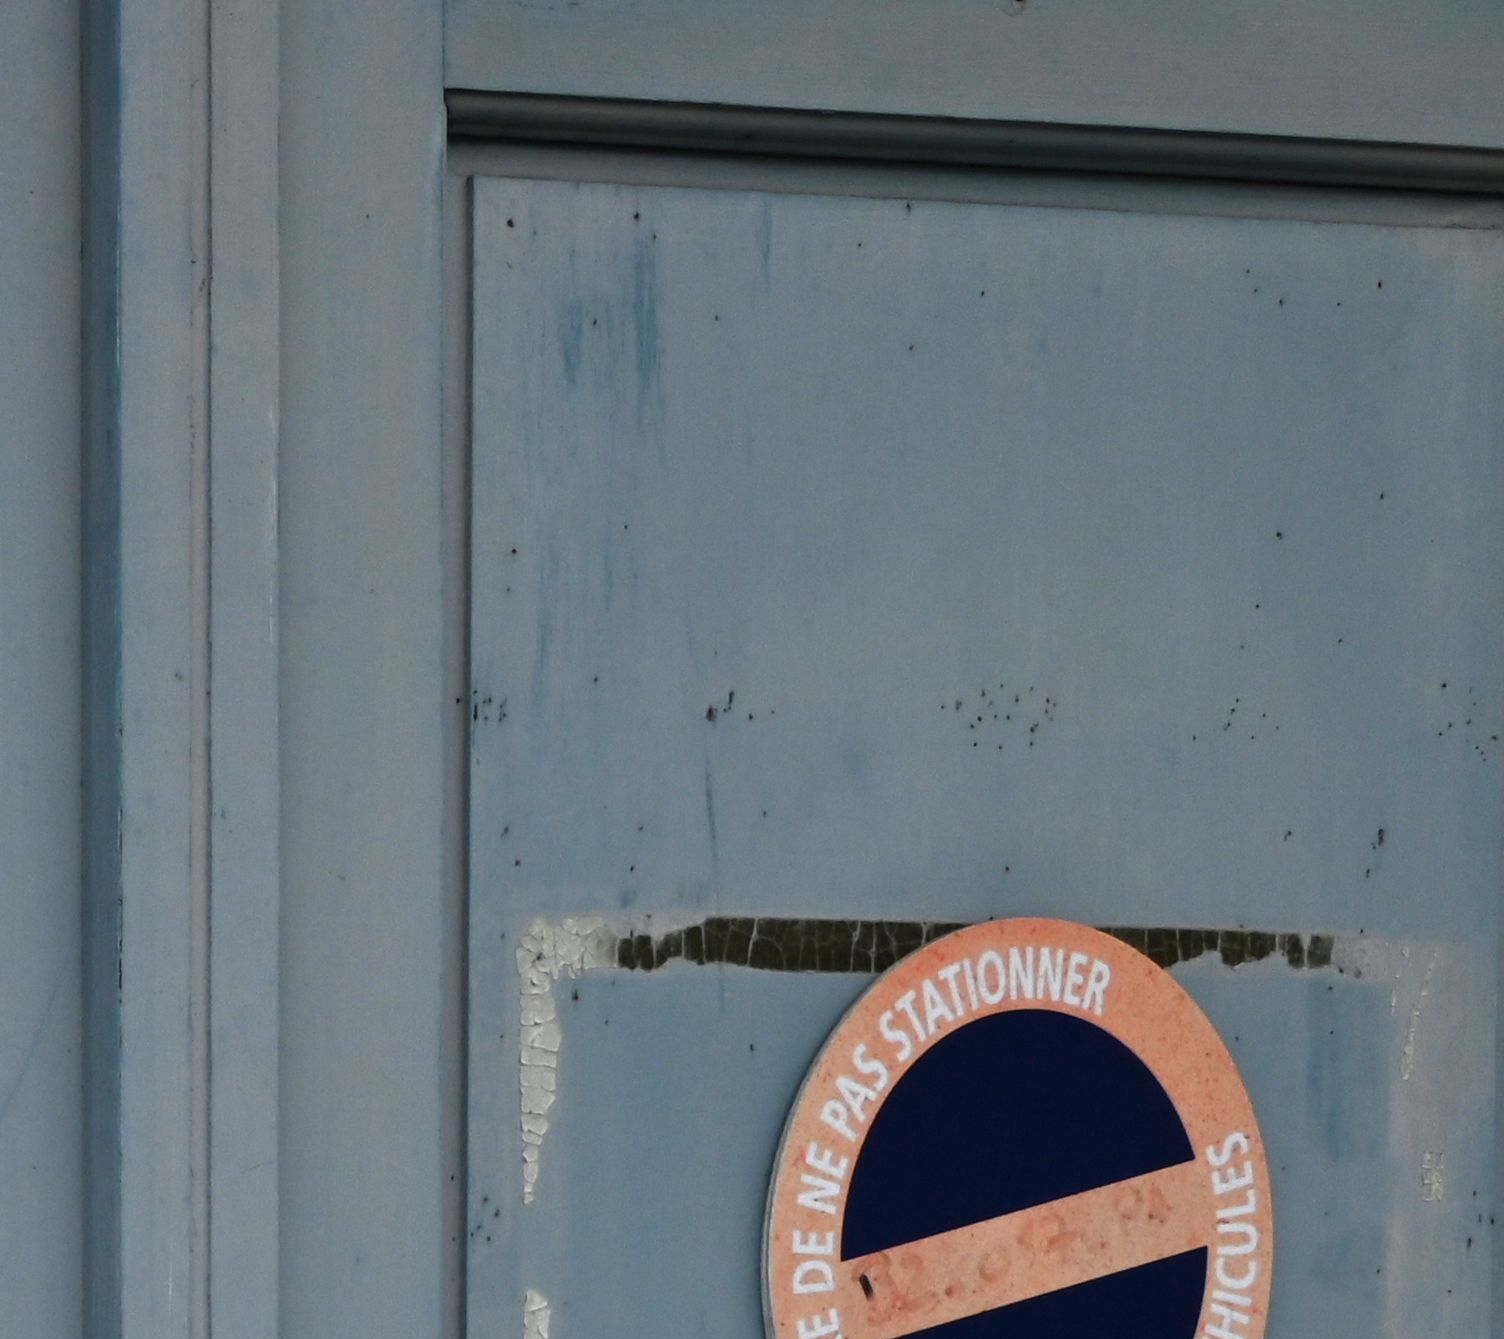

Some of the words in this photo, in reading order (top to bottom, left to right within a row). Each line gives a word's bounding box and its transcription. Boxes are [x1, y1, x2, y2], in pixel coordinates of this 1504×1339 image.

[878, 945, 1113, 1065] STATIONNER
[820, 1044, 890, 1142] PAS
[797, 1141, 850, 1216] NE
[792, 1228, 836, 1297] DE
